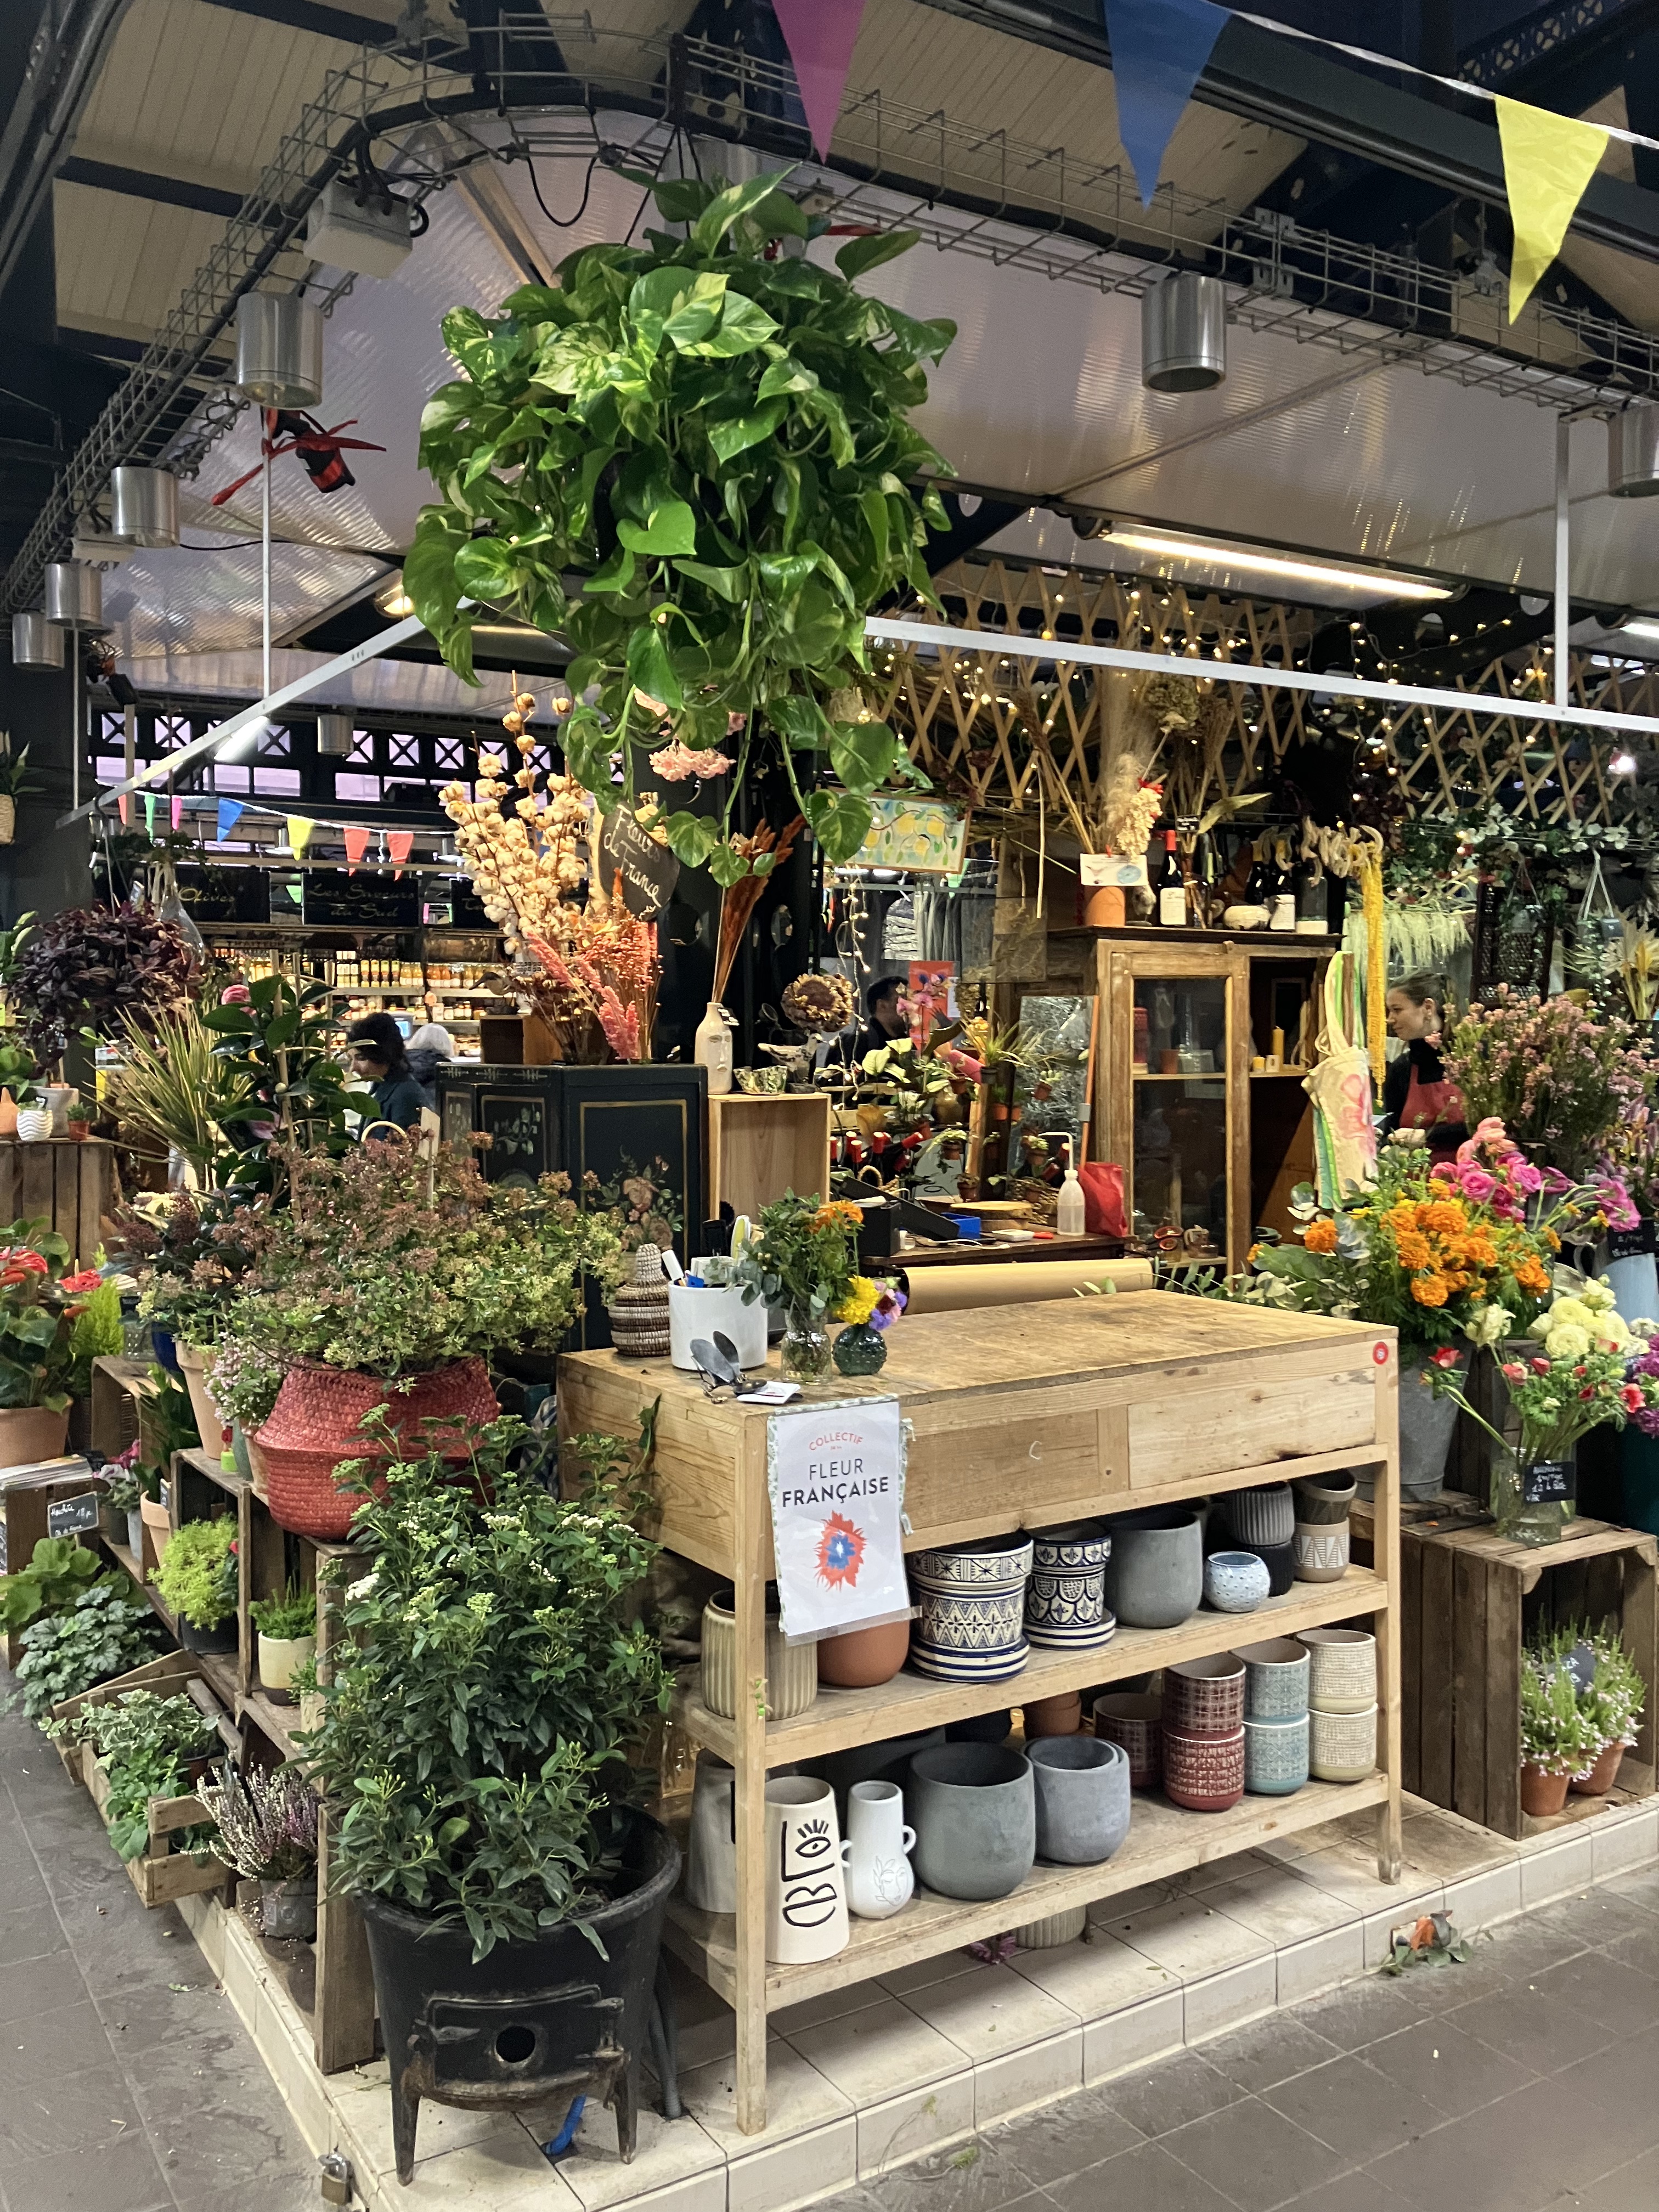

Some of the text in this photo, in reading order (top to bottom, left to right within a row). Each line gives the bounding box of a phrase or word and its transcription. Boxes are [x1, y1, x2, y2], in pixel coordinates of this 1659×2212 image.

[603, 828, 619, 858] de
[619, 839, 662, 908] France
[178, 886, 236, 902] Olives
[358, 902, 399, 919] Sud
[809, 1432, 864, 1451] COLLECTIF
[809, 1458, 864, 1481] FLEUR
[782, 1476, 889, 1508] FRANÇAISE
